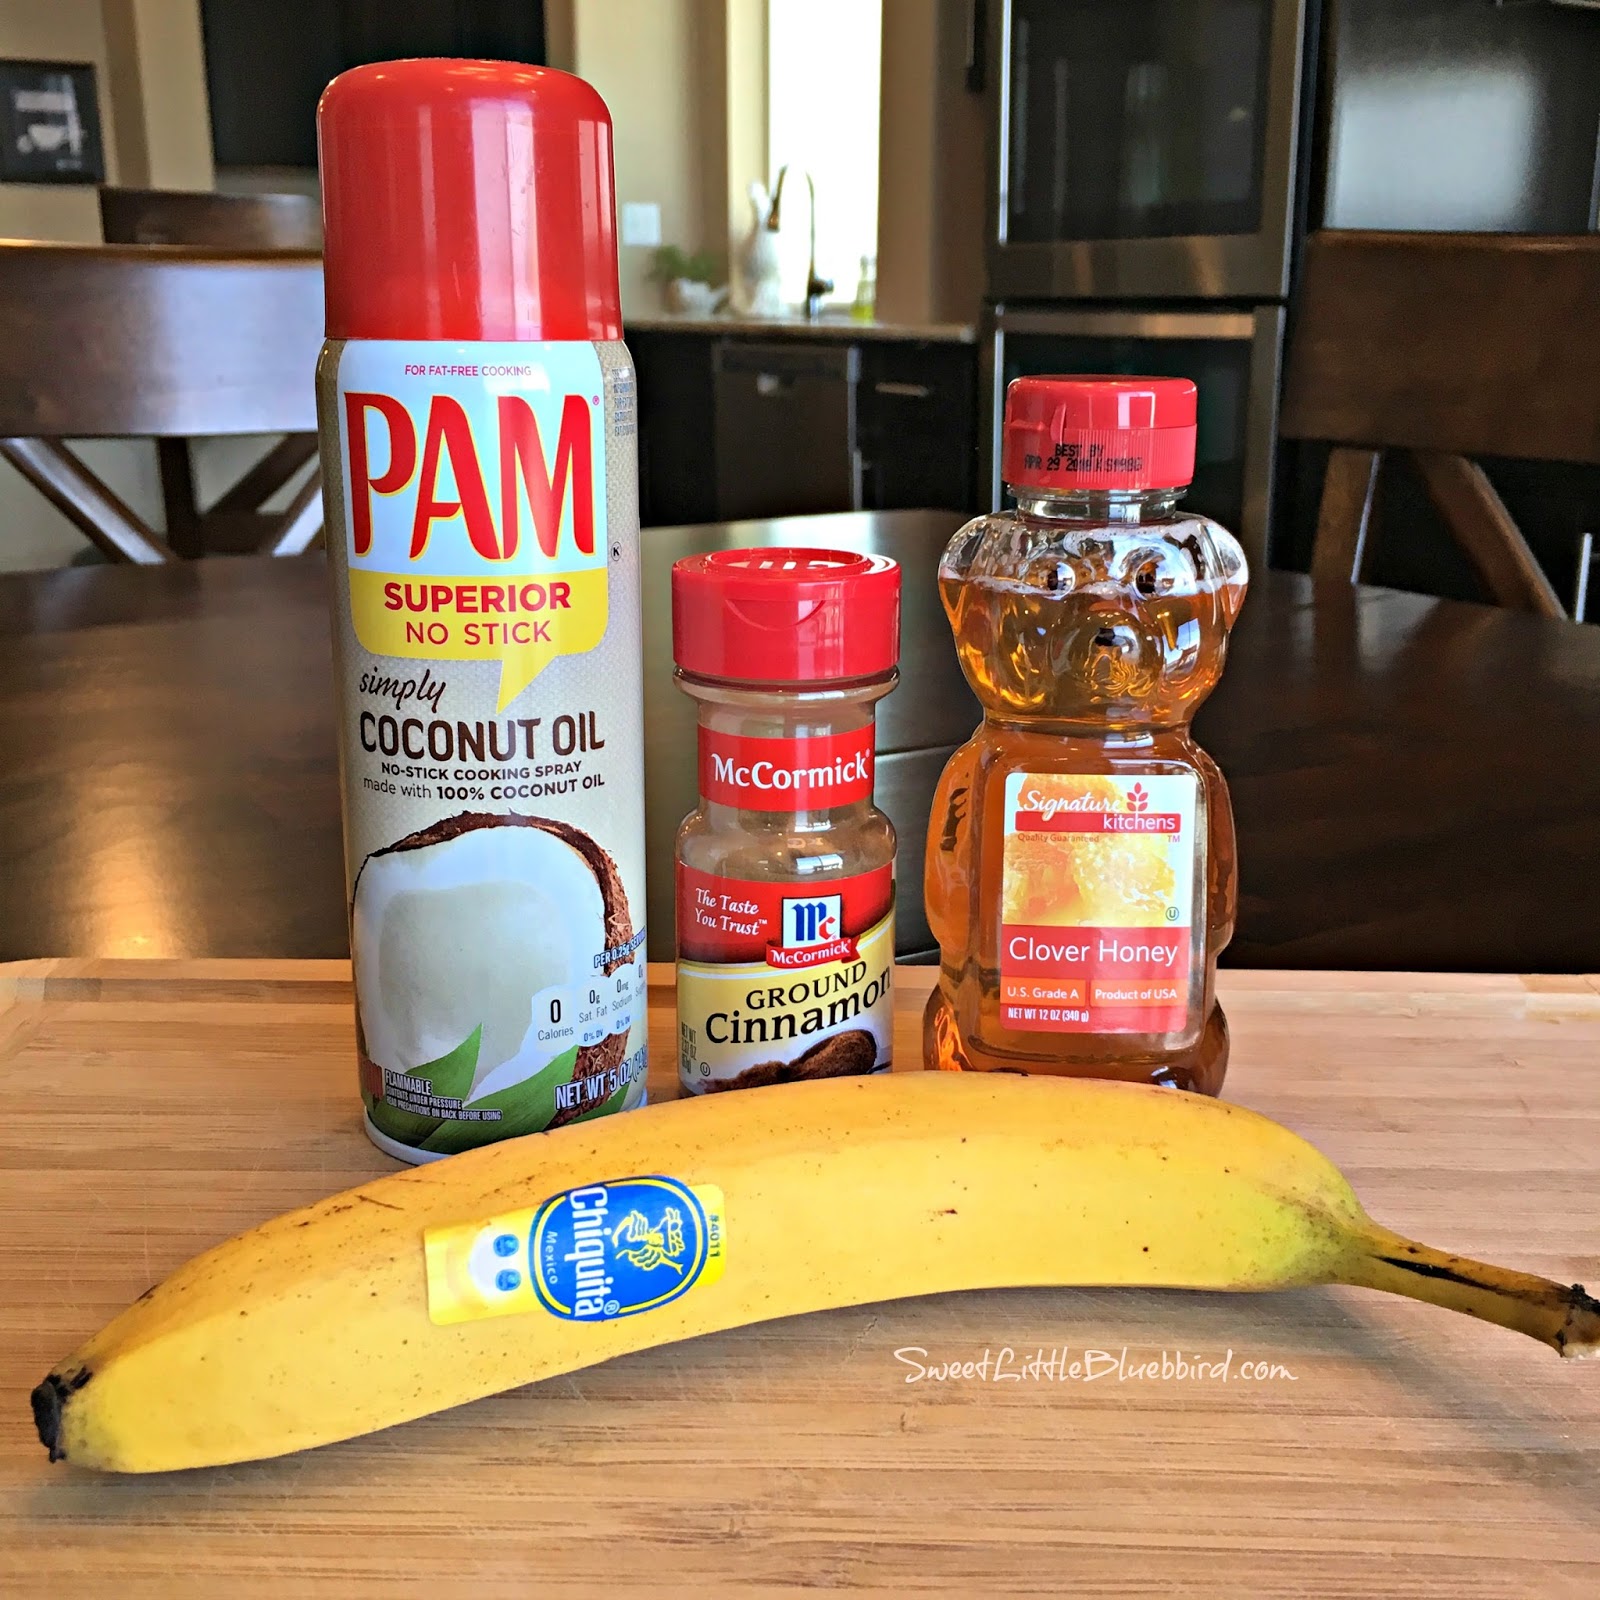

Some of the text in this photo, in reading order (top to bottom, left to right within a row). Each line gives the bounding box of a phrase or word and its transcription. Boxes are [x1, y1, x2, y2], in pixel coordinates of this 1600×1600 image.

[405, 364, 532, 377] FOR FAT-FREE COOKING
[1054, 443, 1082, 457] BEST
[343, 390, 597, 563] PAM
[1046, 457, 1060, 471] 29
[384, 581, 572, 614] SUPERIOR
[405, 620, 553, 646] NO STICK
[359, 666, 447, 713] simply
[359, 710, 606, 762] COCONUT OIL
[381, 760, 583, 782] NO-STICK COOKING SPRAY
[711, 749, 870, 790] McCormick
[363, 773, 606, 801] made with 100% COCONUT OIL
[1023, 789, 1123, 822] Signature
[1103, 813, 1176, 831] kitchens
[1017, 833, 1100, 843] Quality Guaranteed
[695, 887, 759, 915] The Taste
[695, 907, 717, 928] You
[594, 951, 611, 968] PER
[770, 941, 850, 965] McCormick
[1009, 936, 1179, 967] Clover Honey
[745, 960, 867, 1010] GROUND
[1007, 986, 1080, 999] U.S. Grade A
[1094, 988, 1178, 1001] Product of USA
[550, 998, 562, 1024] 0
[596, 1005, 608, 1018] Fat
[705, 966, 891, 1044] Cinnamon
[1007, 1007, 1023, 1019] NET
[1024, 1008, 1037, 1020] WT
[1038, 1009, 1049, 1021] 12
[1050, 1009, 1061, 1021] OZ
[537, 1025, 574, 1042] Calories
[385, 1069, 432, 1096] FLAMMABLE
[555, 1080, 582, 1111] NET
[586, 1072, 607, 1101] WT
[608, 1067, 618, 1092] 5
[619, 1058, 632, 1086] OZ
[409, 1092, 428, 1106] UNDER
[428, 1097, 462, 1110] PRESSURE
[441, 1109, 457, 1120] BACK
[458, 1109, 481, 1121] BEFORE
[482, 1110, 502, 1121] USING
[708, 1213, 721, 1258] #4011
[544, 1230, 559, 1285] Mexico
